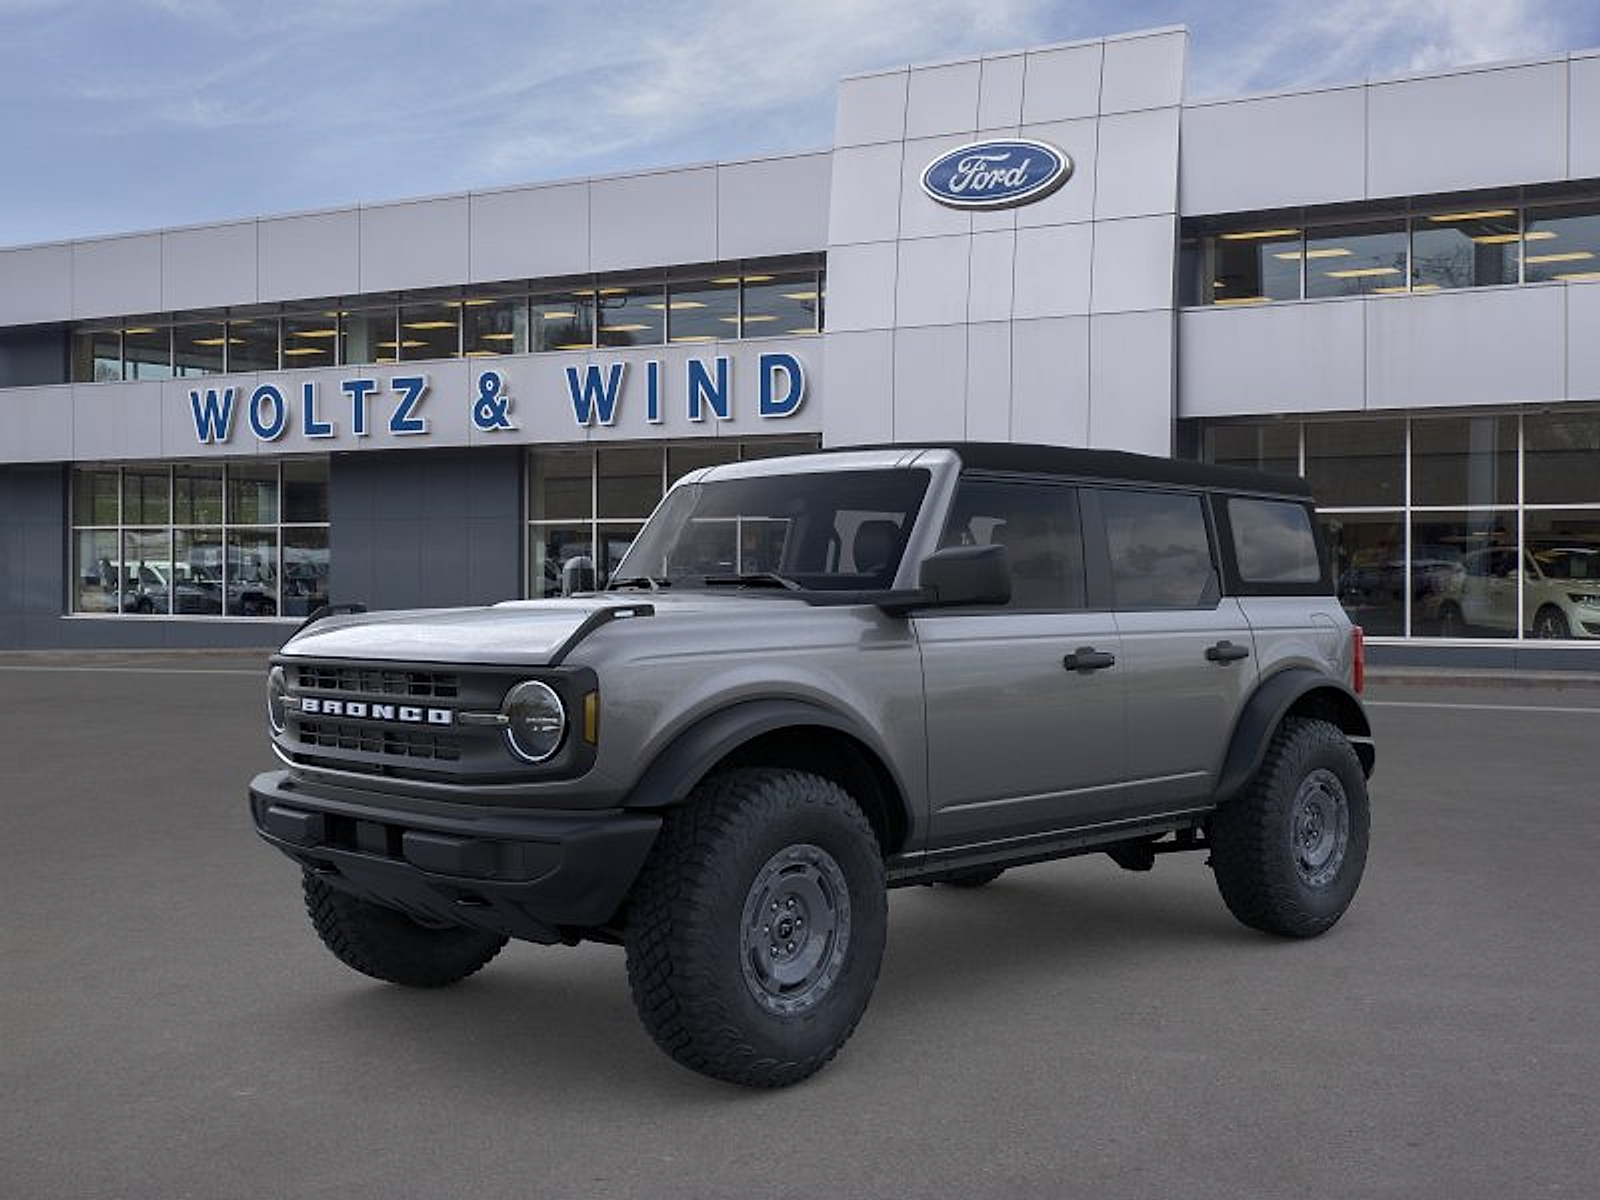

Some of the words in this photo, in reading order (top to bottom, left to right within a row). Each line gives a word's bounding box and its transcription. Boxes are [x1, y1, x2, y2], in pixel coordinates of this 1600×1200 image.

[950, 152, 1031, 193] Ford
[189, 376, 427, 443] WOLTZ
[473, 371, 515, 431] &
[564, 352, 806, 426] WIND
[301, 698, 452, 724] BRONCO
